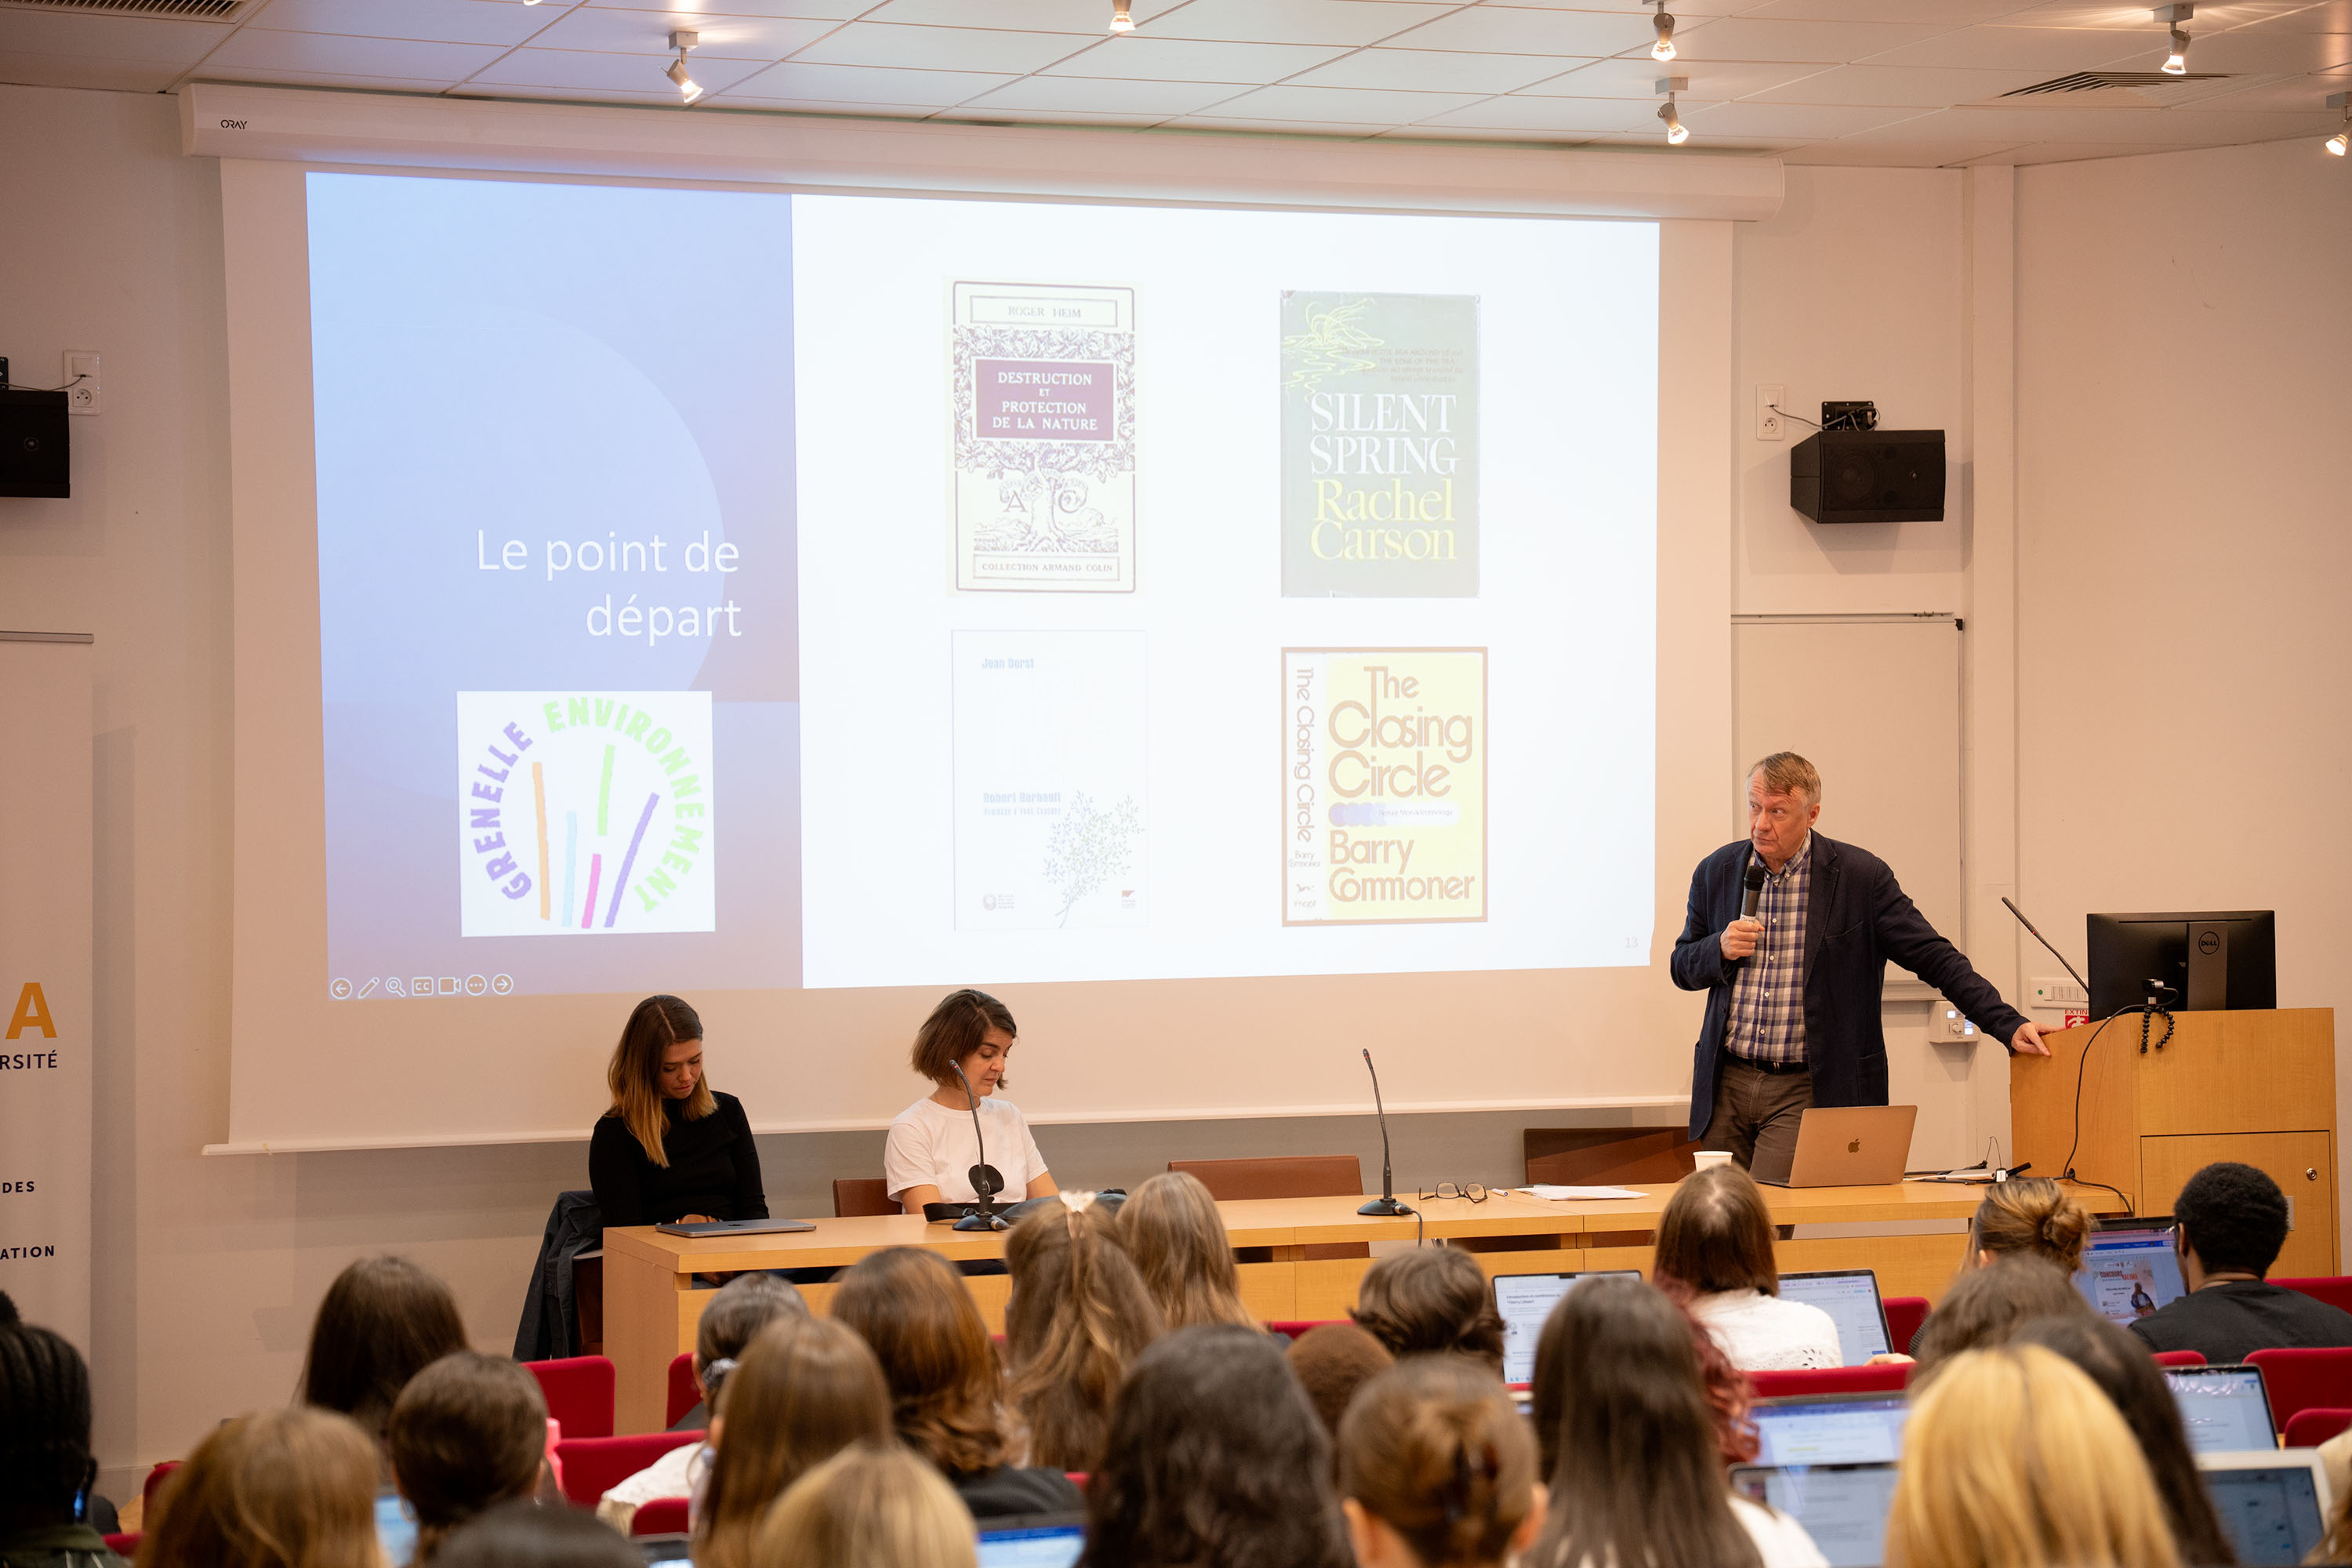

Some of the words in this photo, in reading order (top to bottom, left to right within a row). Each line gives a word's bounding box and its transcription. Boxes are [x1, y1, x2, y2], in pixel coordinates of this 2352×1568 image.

[220, 119, 248, 129] ORAY
[1008, 306, 1045, 318] ROGER
[1053, 307, 1082, 318] HEIM
[997, 372, 1092, 386] DESTRUCTION
[1039, 388, 1051, 397] ET
[993, 416, 1011, 428] DE
[1017, 416, 1035, 429] LA
[1042, 418, 1098, 430] NATURE
[1001, 401, 1086, 414] PROTECTION
[1310, 392, 1457, 433] SILENT
[1309, 435, 1461, 475] SPRING
[1312, 477, 1457, 522] Rachel
[477, 529, 528, 571] Le
[546, 532, 667, 581] point
[684, 529, 740, 572] de
[1310, 520, 1459, 561] Carson
[982, 562, 1040, 572] COLLECTION
[1042, 563, 1082, 572] ARMAND
[1086, 564, 1113, 573] COLIN
[586, 593, 742, 647] départ
[982, 658, 1005, 670] Jean
[1008, 658, 1034, 670] Dorst
[1297, 668, 1315, 702] The
[1363, 666, 1420, 699] The
[1294, 706, 1315, 780] Closing
[1328, 700, 1472, 764] Closing
[1328, 750, 1451, 798] Circle
[470, 721, 534, 900] GRENELLE
[543, 696, 705, 913] ENVIRONNEMENT
[983, 791, 1016, 804] Robert
[1297, 784, 1315, 843] Circle
[1330, 829, 1414, 874] Barry
[1329, 866, 1475, 902] Commoner
[5, 982, 57, 1040] A
[0, 1049, 57, 1070] RSITÉ
[2, 1181, 35, 1193] DES
[0, 1245, 55, 1260] ATION
